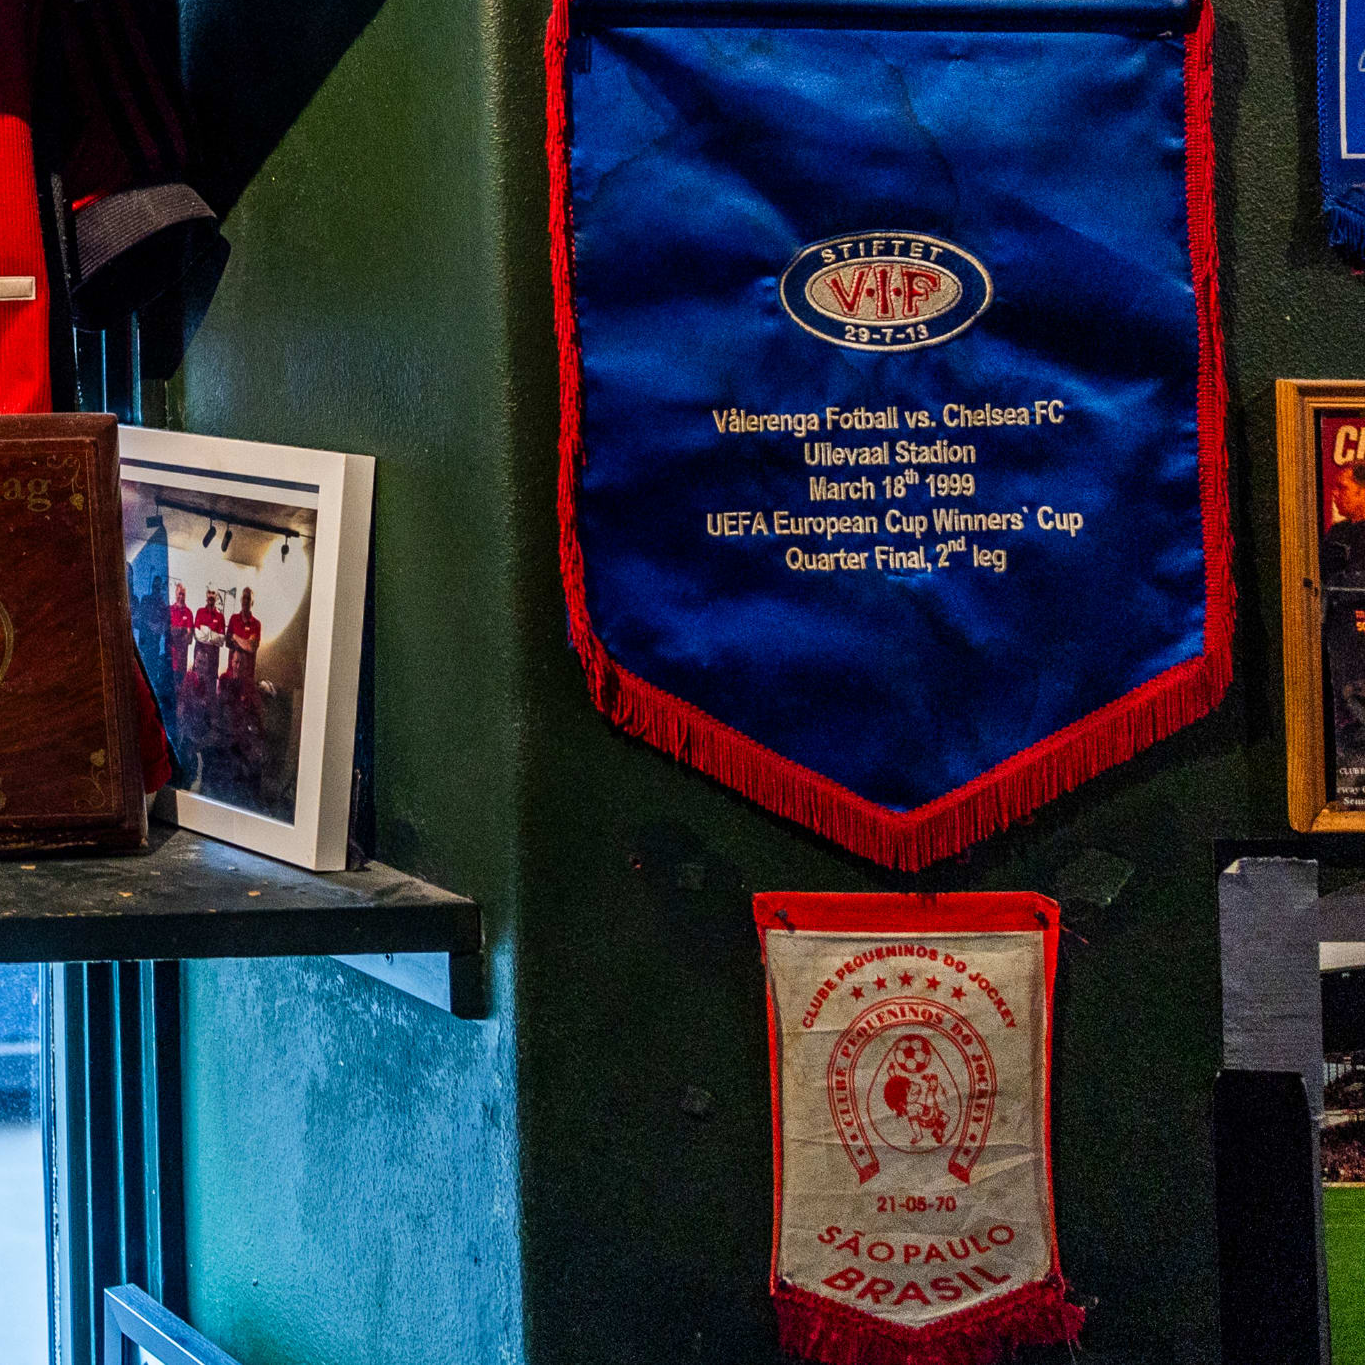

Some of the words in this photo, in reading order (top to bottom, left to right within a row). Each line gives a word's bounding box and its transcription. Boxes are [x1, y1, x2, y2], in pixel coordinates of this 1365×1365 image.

[821, 242, 944, 264] STIFTET
[845, 324, 929, 343] 29-7-13
[712, 407, 819, 437] Vålerenga
[826, 405, 898, 431] Fotball
[905, 410, 936, 428] vs.
[943, 403, 1029, 428] Chelsea
[1034, 400, 1065, 425] FC
[804, 442, 889, 467] Ullevaal
[895, 440, 976, 465] Stadion
[809, 475, 875, 501] March
[882, 469, 919, 498] 18th
[925, 474, 976, 497] 1999
[707, 512, 767, 537] UEFA
[773, 511, 878, 540] European
[885, 510, 928, 539] Cup
[1037, 506, 1084, 536] Cup
[786, 547, 868, 573] Quarter
[875, 546, 932, 572] Final,
[936, 536, 967, 569] 2nd
[973, 546, 1007, 573] leg
[802, 978, 838, 1029] CLUBE
[833, 944, 939, 983] PEQUENINOS
[943, 952, 968, 975] DO
[968, 971, 1017, 1030] JOCKEY
[877, 1196, 957, 1213] 21-05-70
[817, 1224, 895, 1263] SÃO
[902, 1224, 1016, 1265] PAULO
[820, 1265, 1012, 1307] BRASIL
